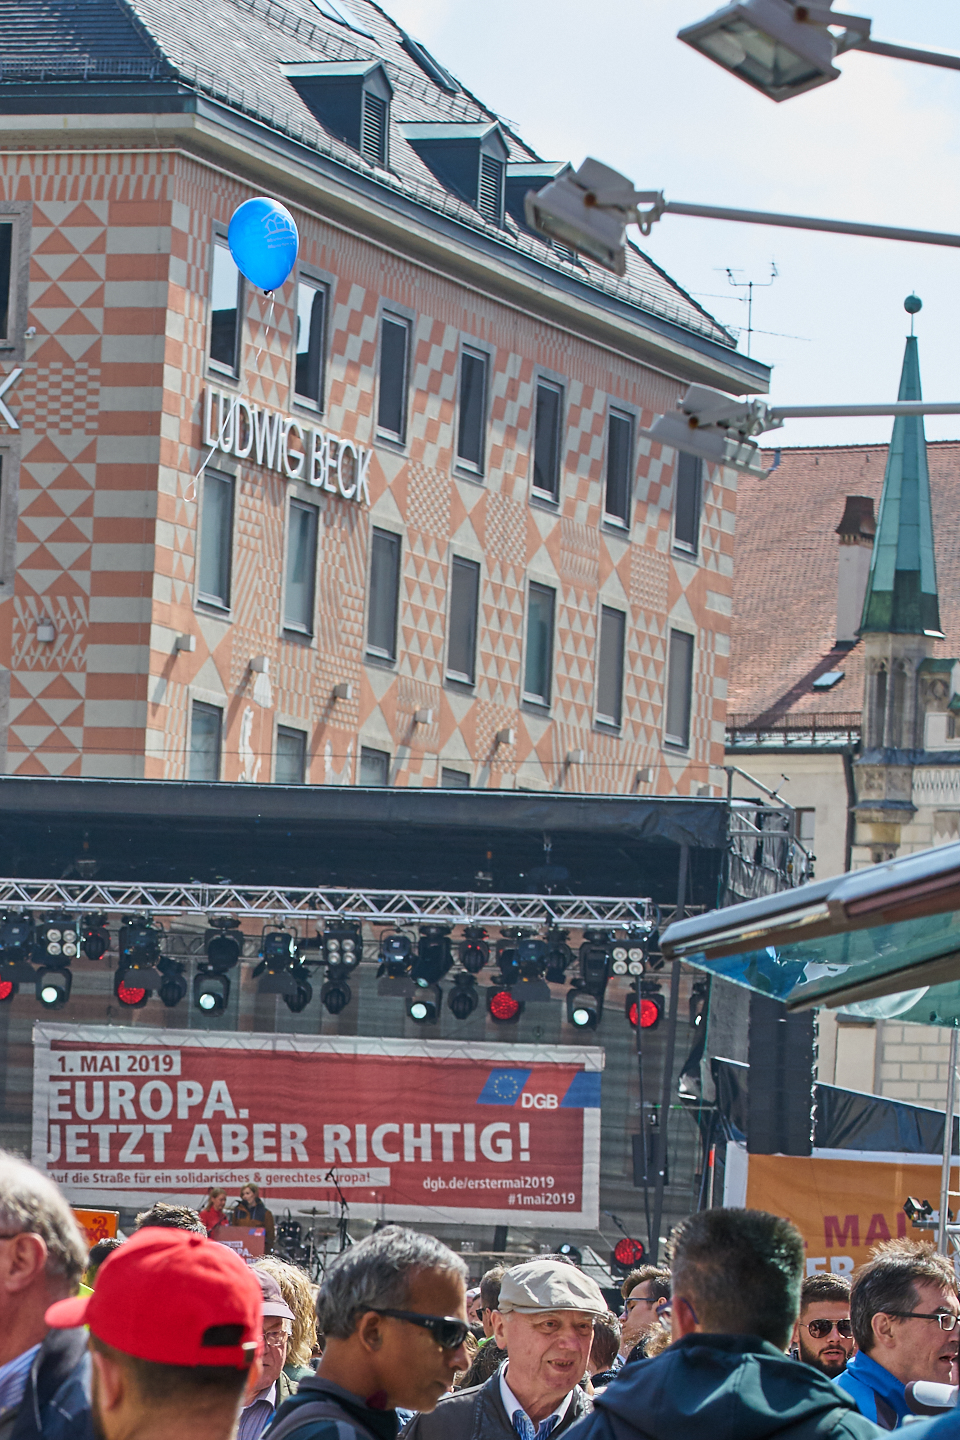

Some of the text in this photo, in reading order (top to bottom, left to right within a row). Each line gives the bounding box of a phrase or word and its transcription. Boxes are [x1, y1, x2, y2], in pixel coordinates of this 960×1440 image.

[203, 385, 373, 506] LUDWIG BECK
[57, 1054, 174, 1073] 1. MAI 2019
[49, 1080, 249, 1121] EUROPA.
[521, 1092, 558, 1109] DGB
[47, 1122, 531, 1163] JETZT ABER RICHTIG!
[72, 1172, 90, 1184] die
[93, 1172, 131, 1184] Straße
[134, 1172, 152, 1184] für
[154, 1172, 172, 1184] ein
[175, 1172, 250, 1184] solidarisches
[253, 1172, 262, 1183] &
[265, 1172, 322, 1185] gerechtes
[422, 1176, 555, 1192] dgb.de/erstermai2019
[508, 1192, 576, 1205] #1mai2019
